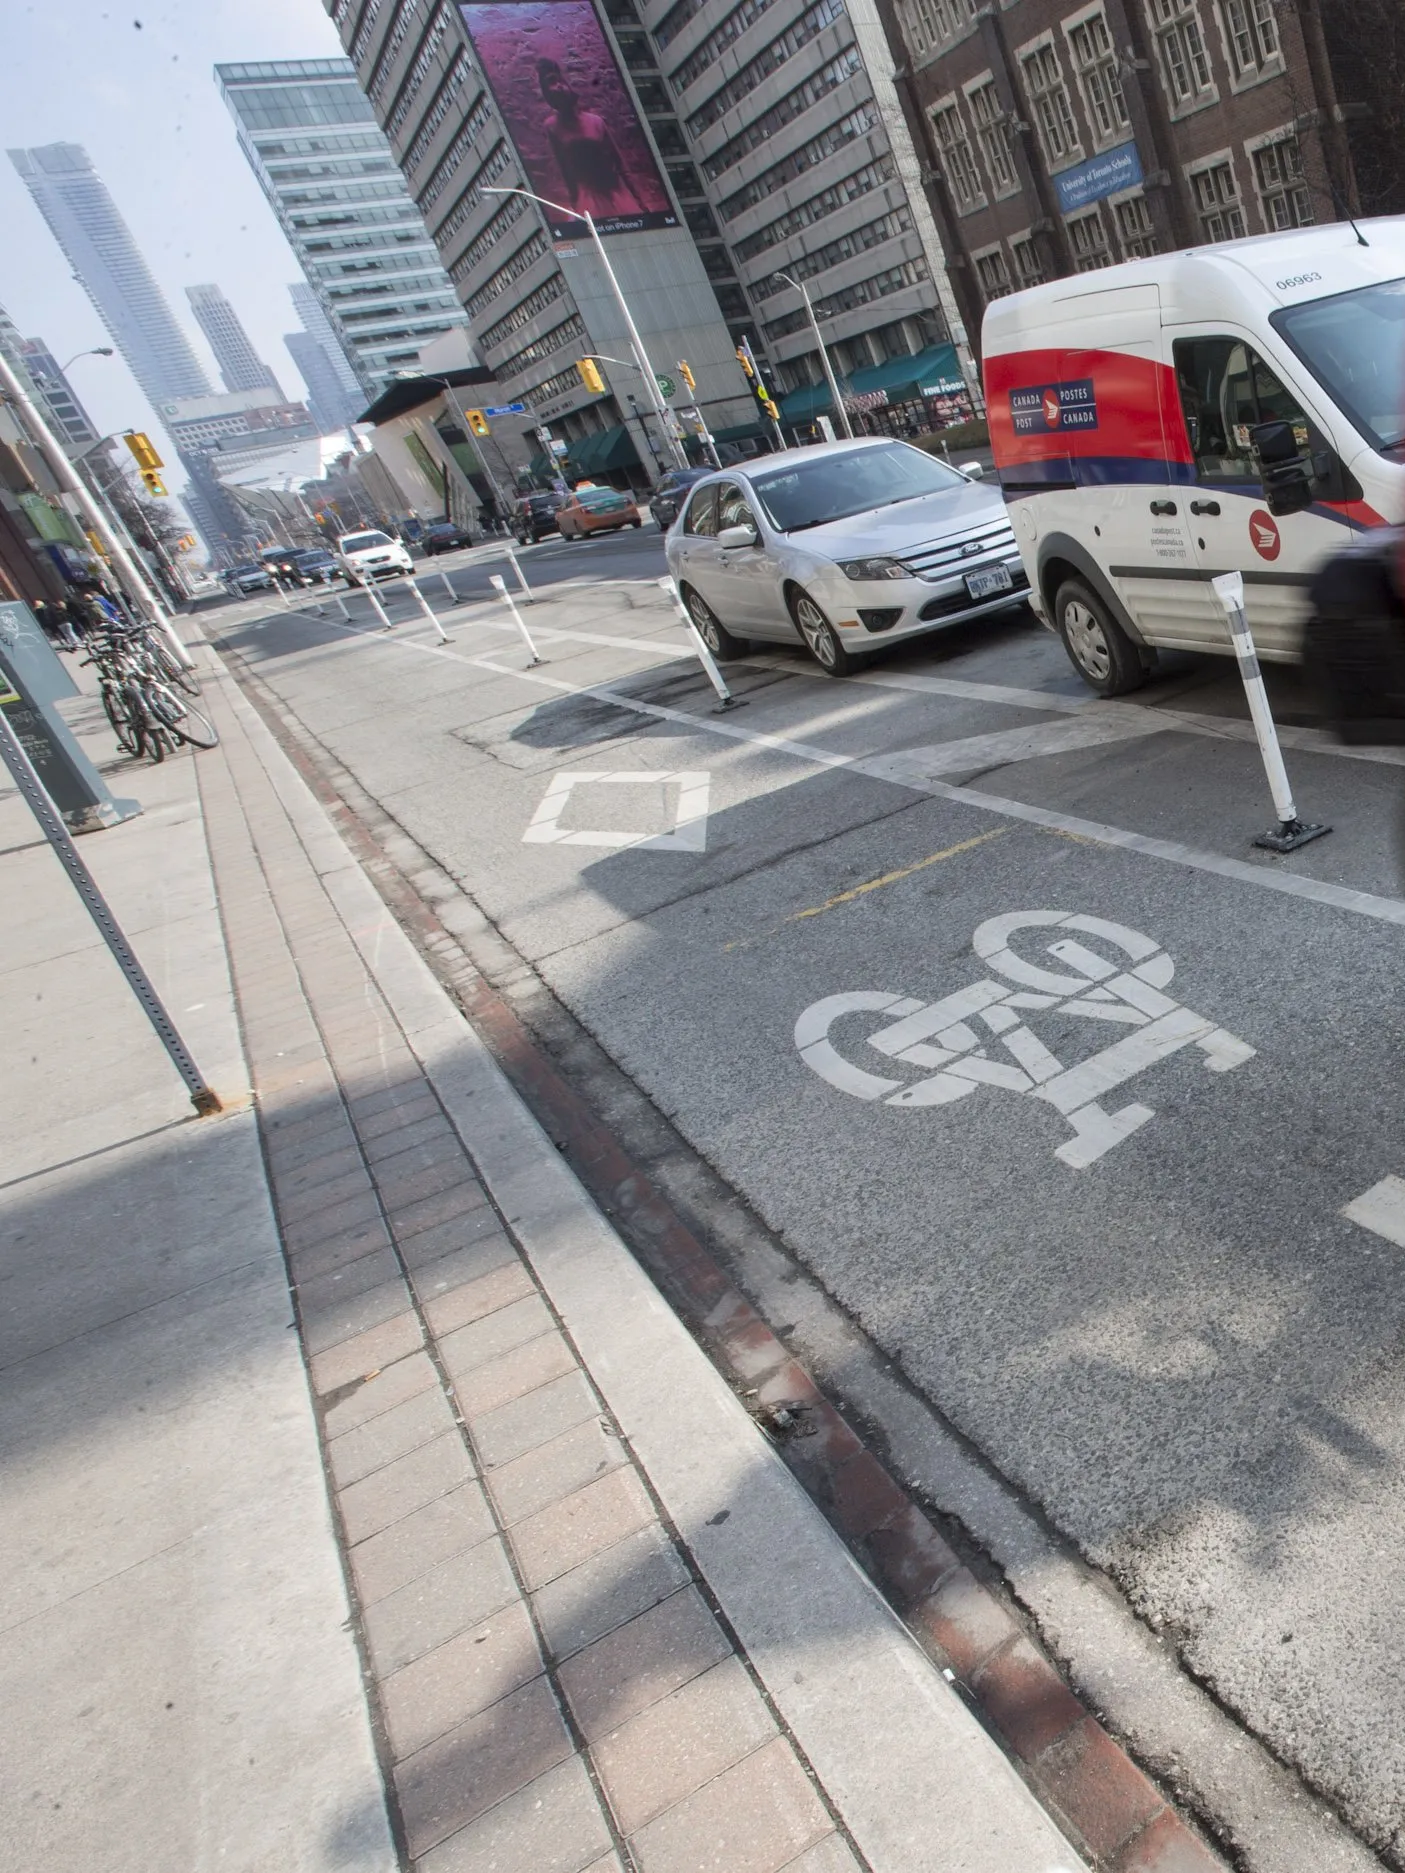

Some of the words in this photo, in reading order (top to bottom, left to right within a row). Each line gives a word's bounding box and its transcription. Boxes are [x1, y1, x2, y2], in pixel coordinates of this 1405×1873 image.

[1062, 174, 1087, 193] University
[1086, 171, 1093, 182] of
[1092, 164, 1112, 179] Toronto
[1111, 154, 1132, 170] Schools
[615, 221, 639, 230] iPhone
[638, 219, 644, 227] 7
[1276, 272, 1322, 290] 06963
[923, 385, 941, 396] FINE
[941, 380, 966, 393] FOODS
[1012, 394, 1041, 407] CANADA
[1060, 388, 1088, 401] POSTES
[1016, 417, 1033, 429] POST
[1063, 411, 1095, 425] CANADA
